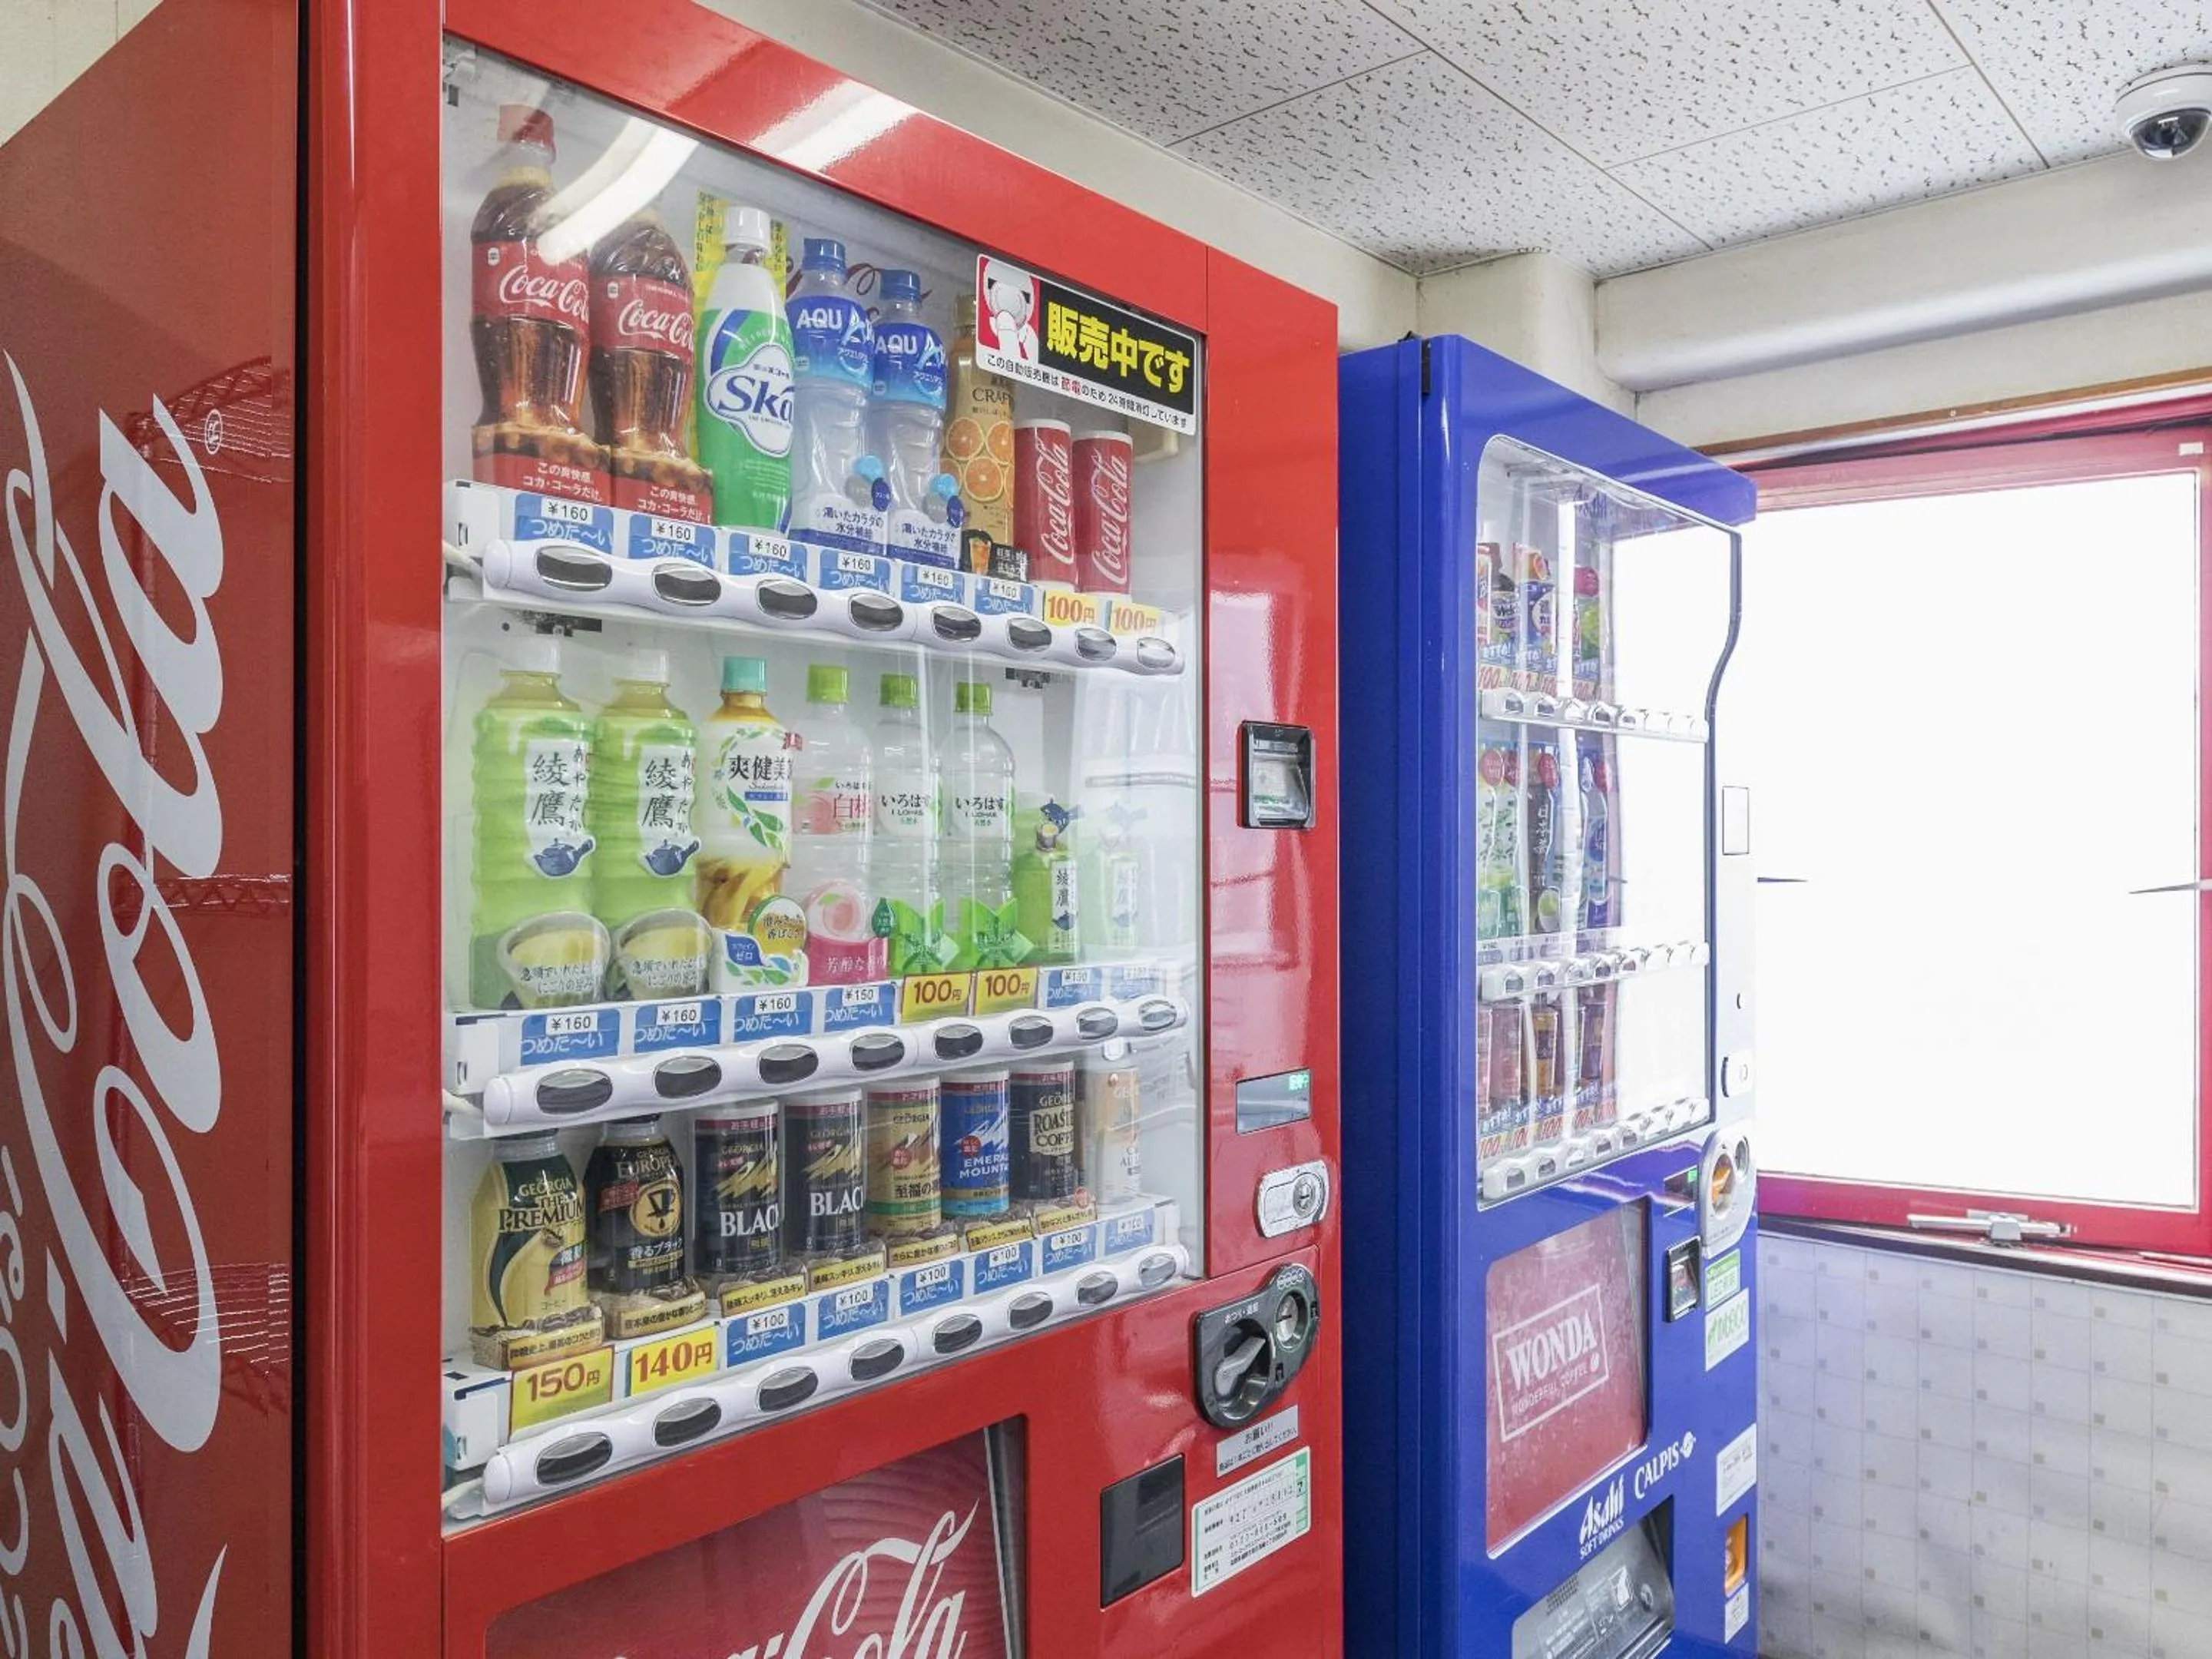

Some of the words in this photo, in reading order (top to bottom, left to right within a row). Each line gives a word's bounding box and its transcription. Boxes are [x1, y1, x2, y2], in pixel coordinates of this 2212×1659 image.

[1047, 302, 1191, 393] 販売中です
[1037, 435, 1075, 565] Coca-Cola
[547, 503, 588, 522] ¥160
[1091, 449, 1128, 586] Coca-Cola
[656, 525, 691, 540] ¥160
[754, 539, 787, 558] ¥160
[842, 555, 872, 571] ¥160
[1047, 595, 1095, 624] 100円
[1114, 607, 1157, 631] 100円
[531, 751, 571, 826] 綾鷹
[641, 757, 678, 829] 綾鷹
[735, 949, 754, 961] ゼロ
[846, 988, 874, 1002] ¥150
[913, 979, 962, 1005] 100円
[985, 973, 1031, 998] 100円
[661, 1008, 697, 1023] ¥160
[759, 997, 792, 1012] ¥160
[551, 1015, 591, 1031] ¥160
[518, 1177, 575, 1197] GEORGIA
[810, 1185, 864, 1216] BLAC
[919, 1266, 947, 1282] ¥100
[839, 1290, 869, 1306] ¥100
[753, 1313, 785, 1330] ¥100
[635, 1340, 714, 1382] 140円
[1505, 1309, 1598, 1392] WONDA
[525, 1362, 601, 1404] 150円
[1579, 1474, 1624, 1545] Asahi
[1634, 1441, 1680, 1499] CALPIS
[1580, 1539, 1598, 1561] SOFT
